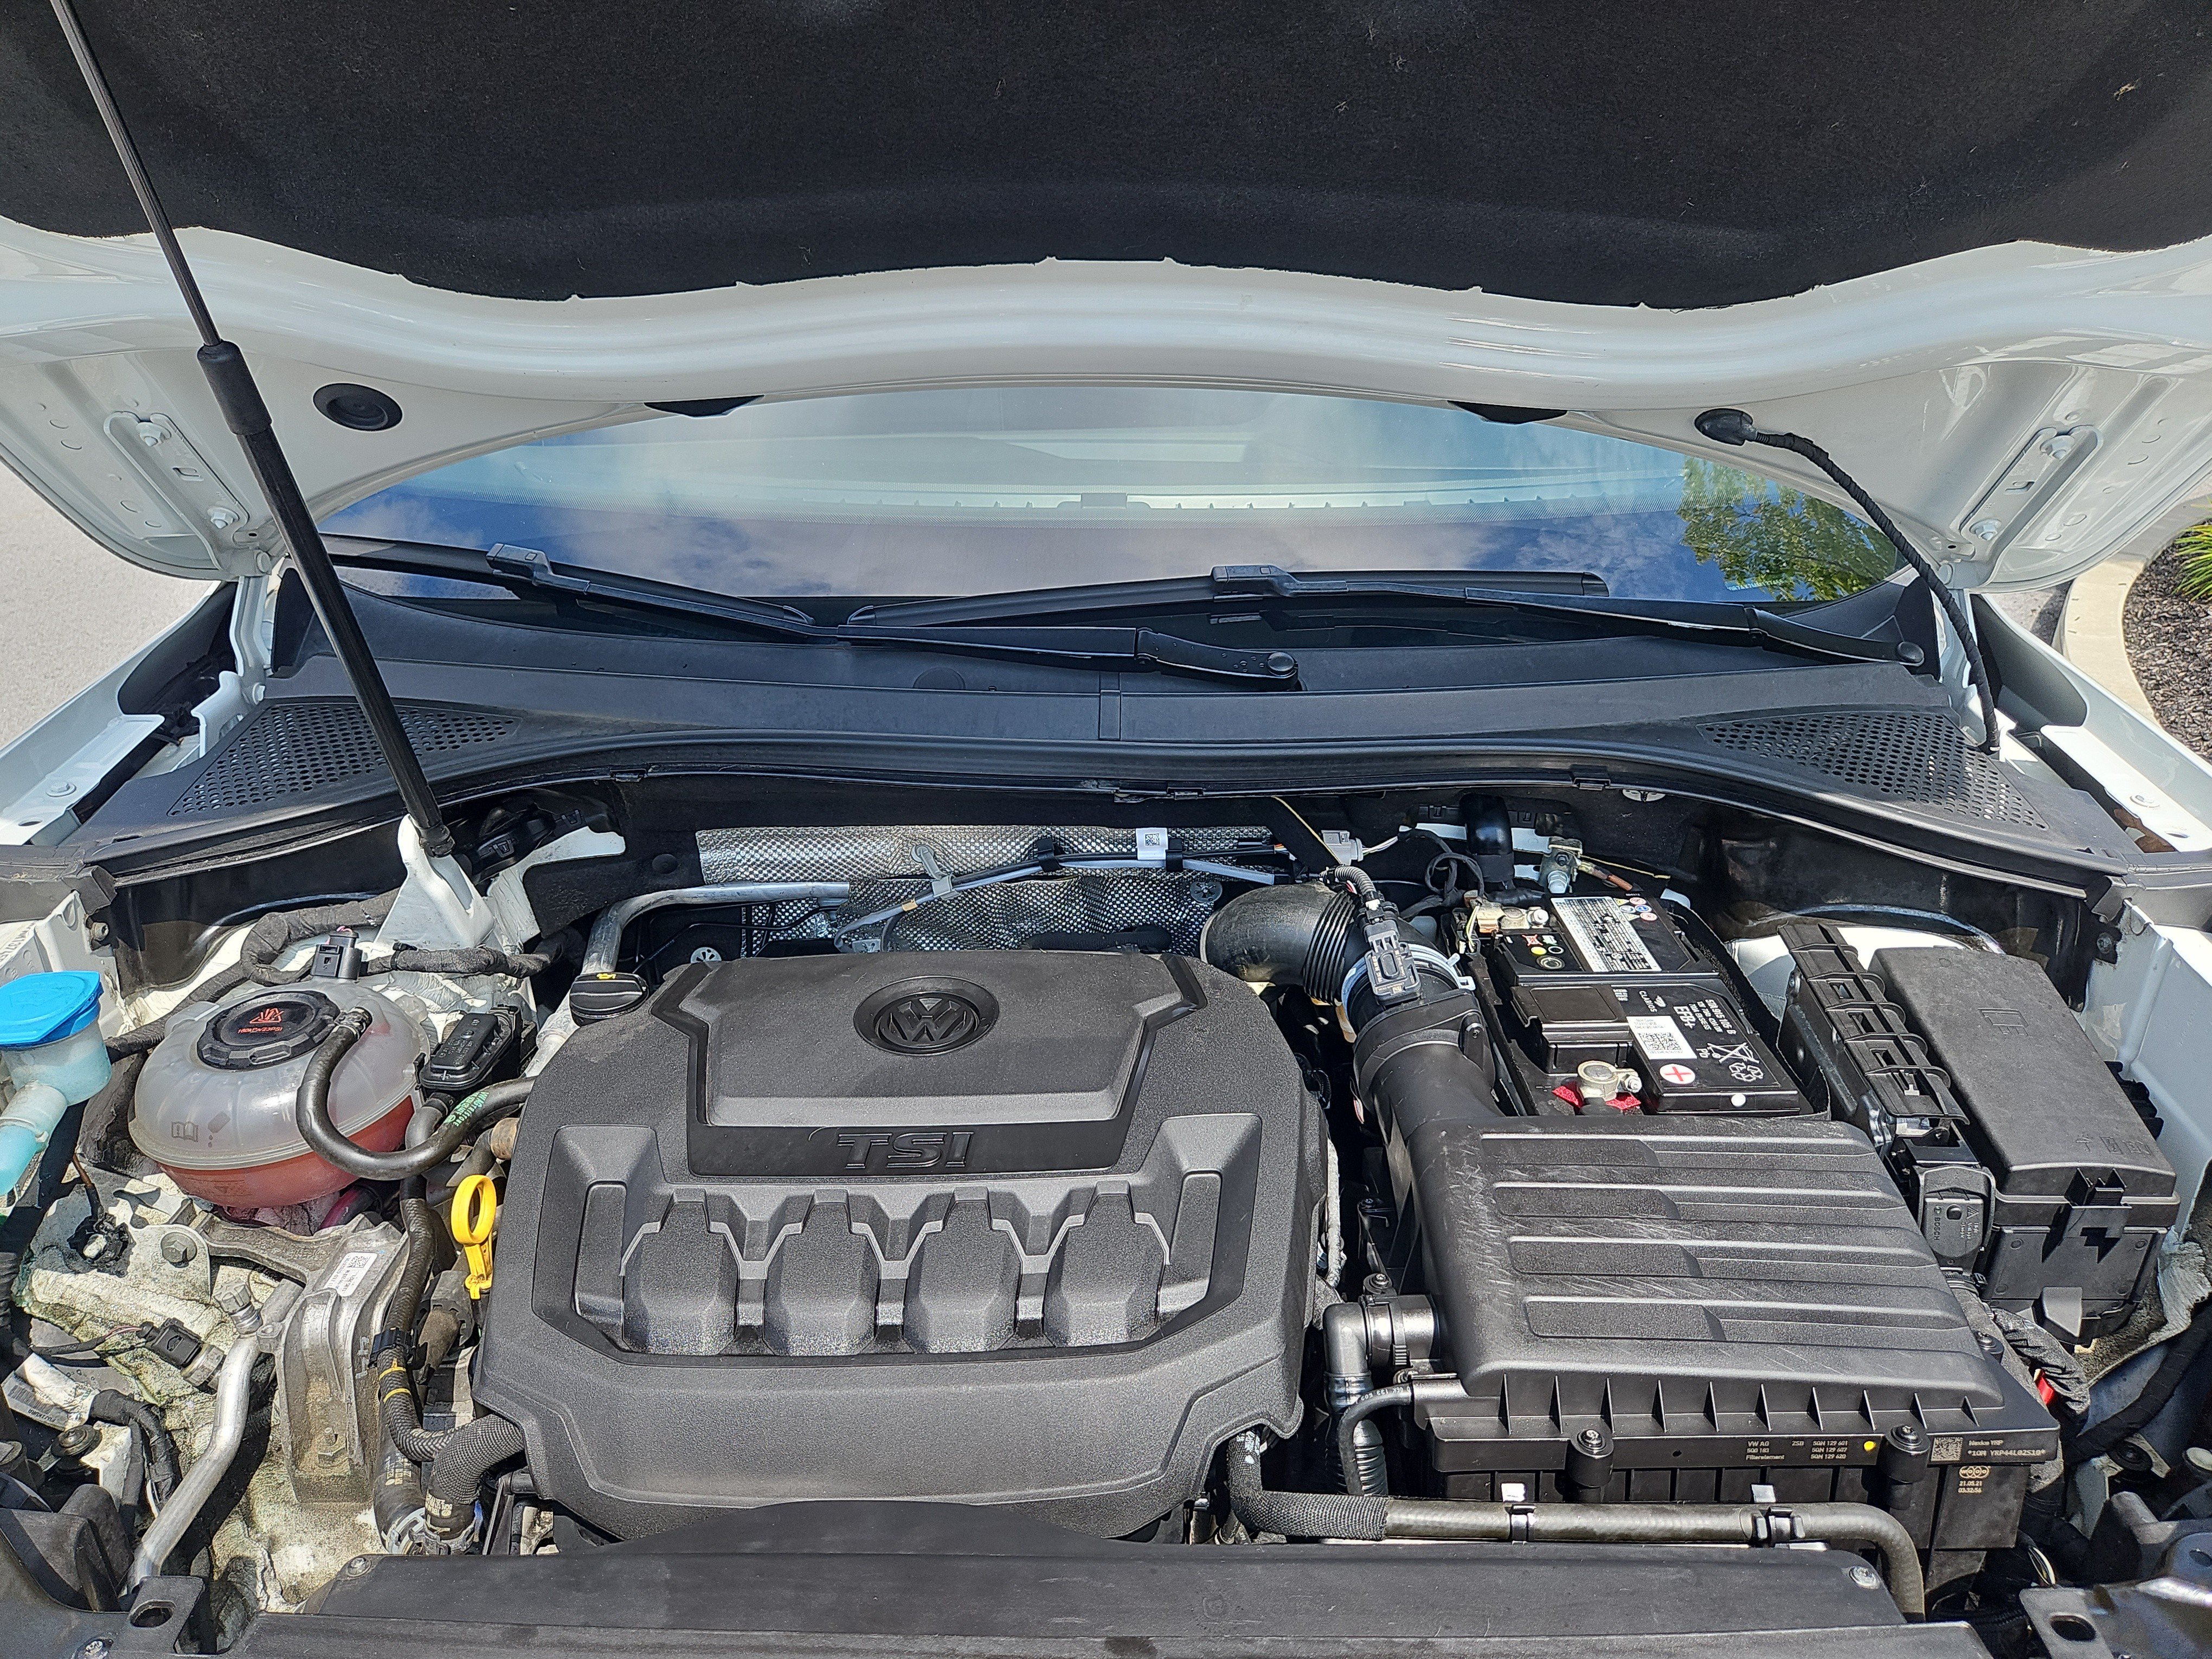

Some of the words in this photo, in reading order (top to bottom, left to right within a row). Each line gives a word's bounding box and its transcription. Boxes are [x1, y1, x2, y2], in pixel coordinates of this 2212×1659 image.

[1638, 991, 1657, 1013] CLARIOS
[1673, 1006, 1696, 1029] EFB+
[1719, 1019, 1732, 1029] 105
[1696, 1048, 1711, 1058] Pb
[838, 1132, 974, 1169] TSI
[28, 1409, 56, 1423] FUJIKURA
